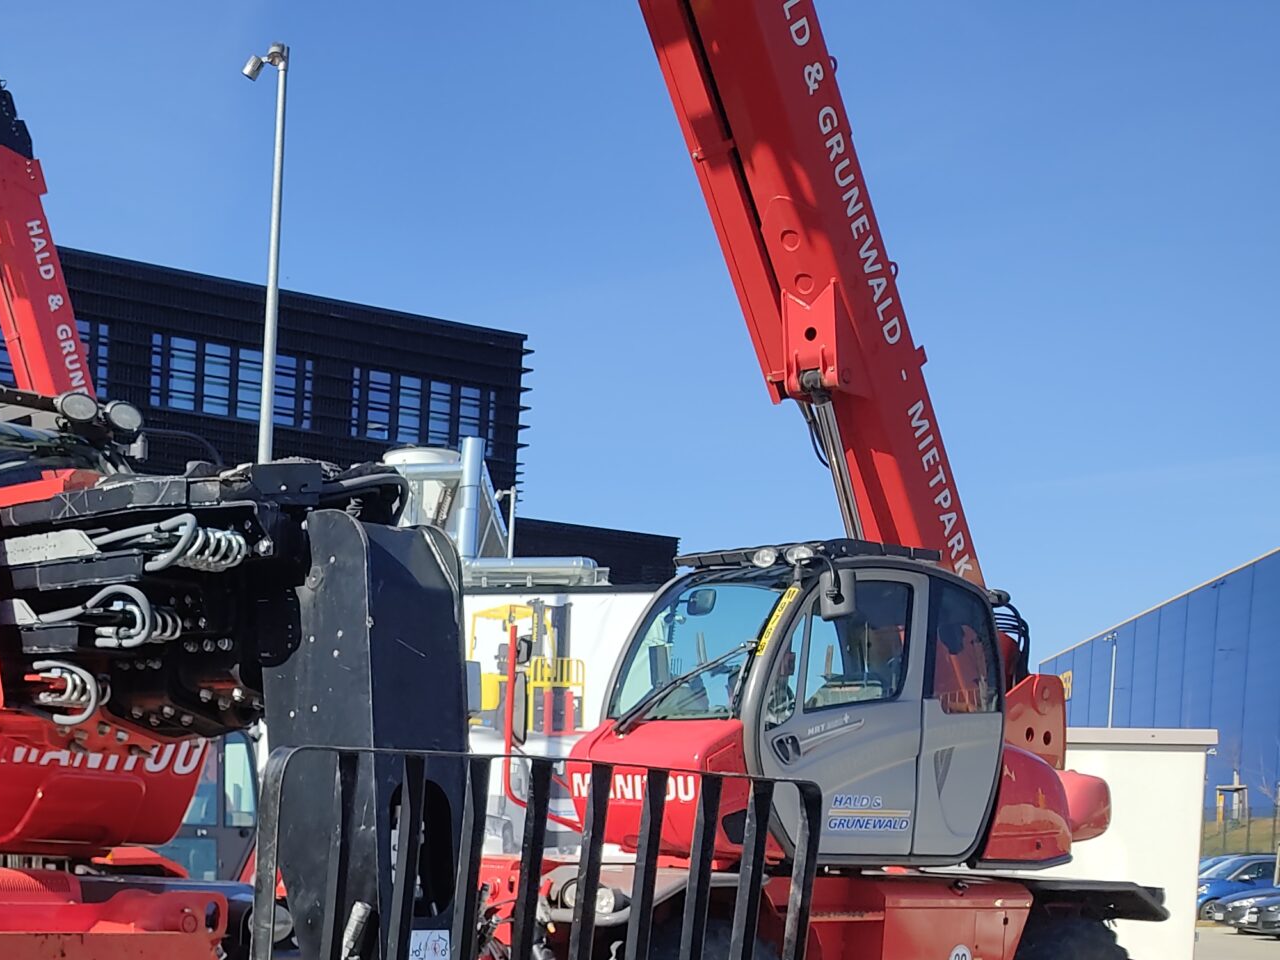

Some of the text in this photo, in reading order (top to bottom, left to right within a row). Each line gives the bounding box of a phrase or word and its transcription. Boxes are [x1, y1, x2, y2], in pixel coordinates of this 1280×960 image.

[26, 220, 55, 280] HALD
[48, 294, 64, 312] &
[804, 62, 824, 95] &
[818, 106, 902, 345] GRUNEWALD
[907, 400, 972, 577] MIETPARK
[828, 817, 909, 831] GRUNEWALD
[833, 795, 869, 808] HALD
